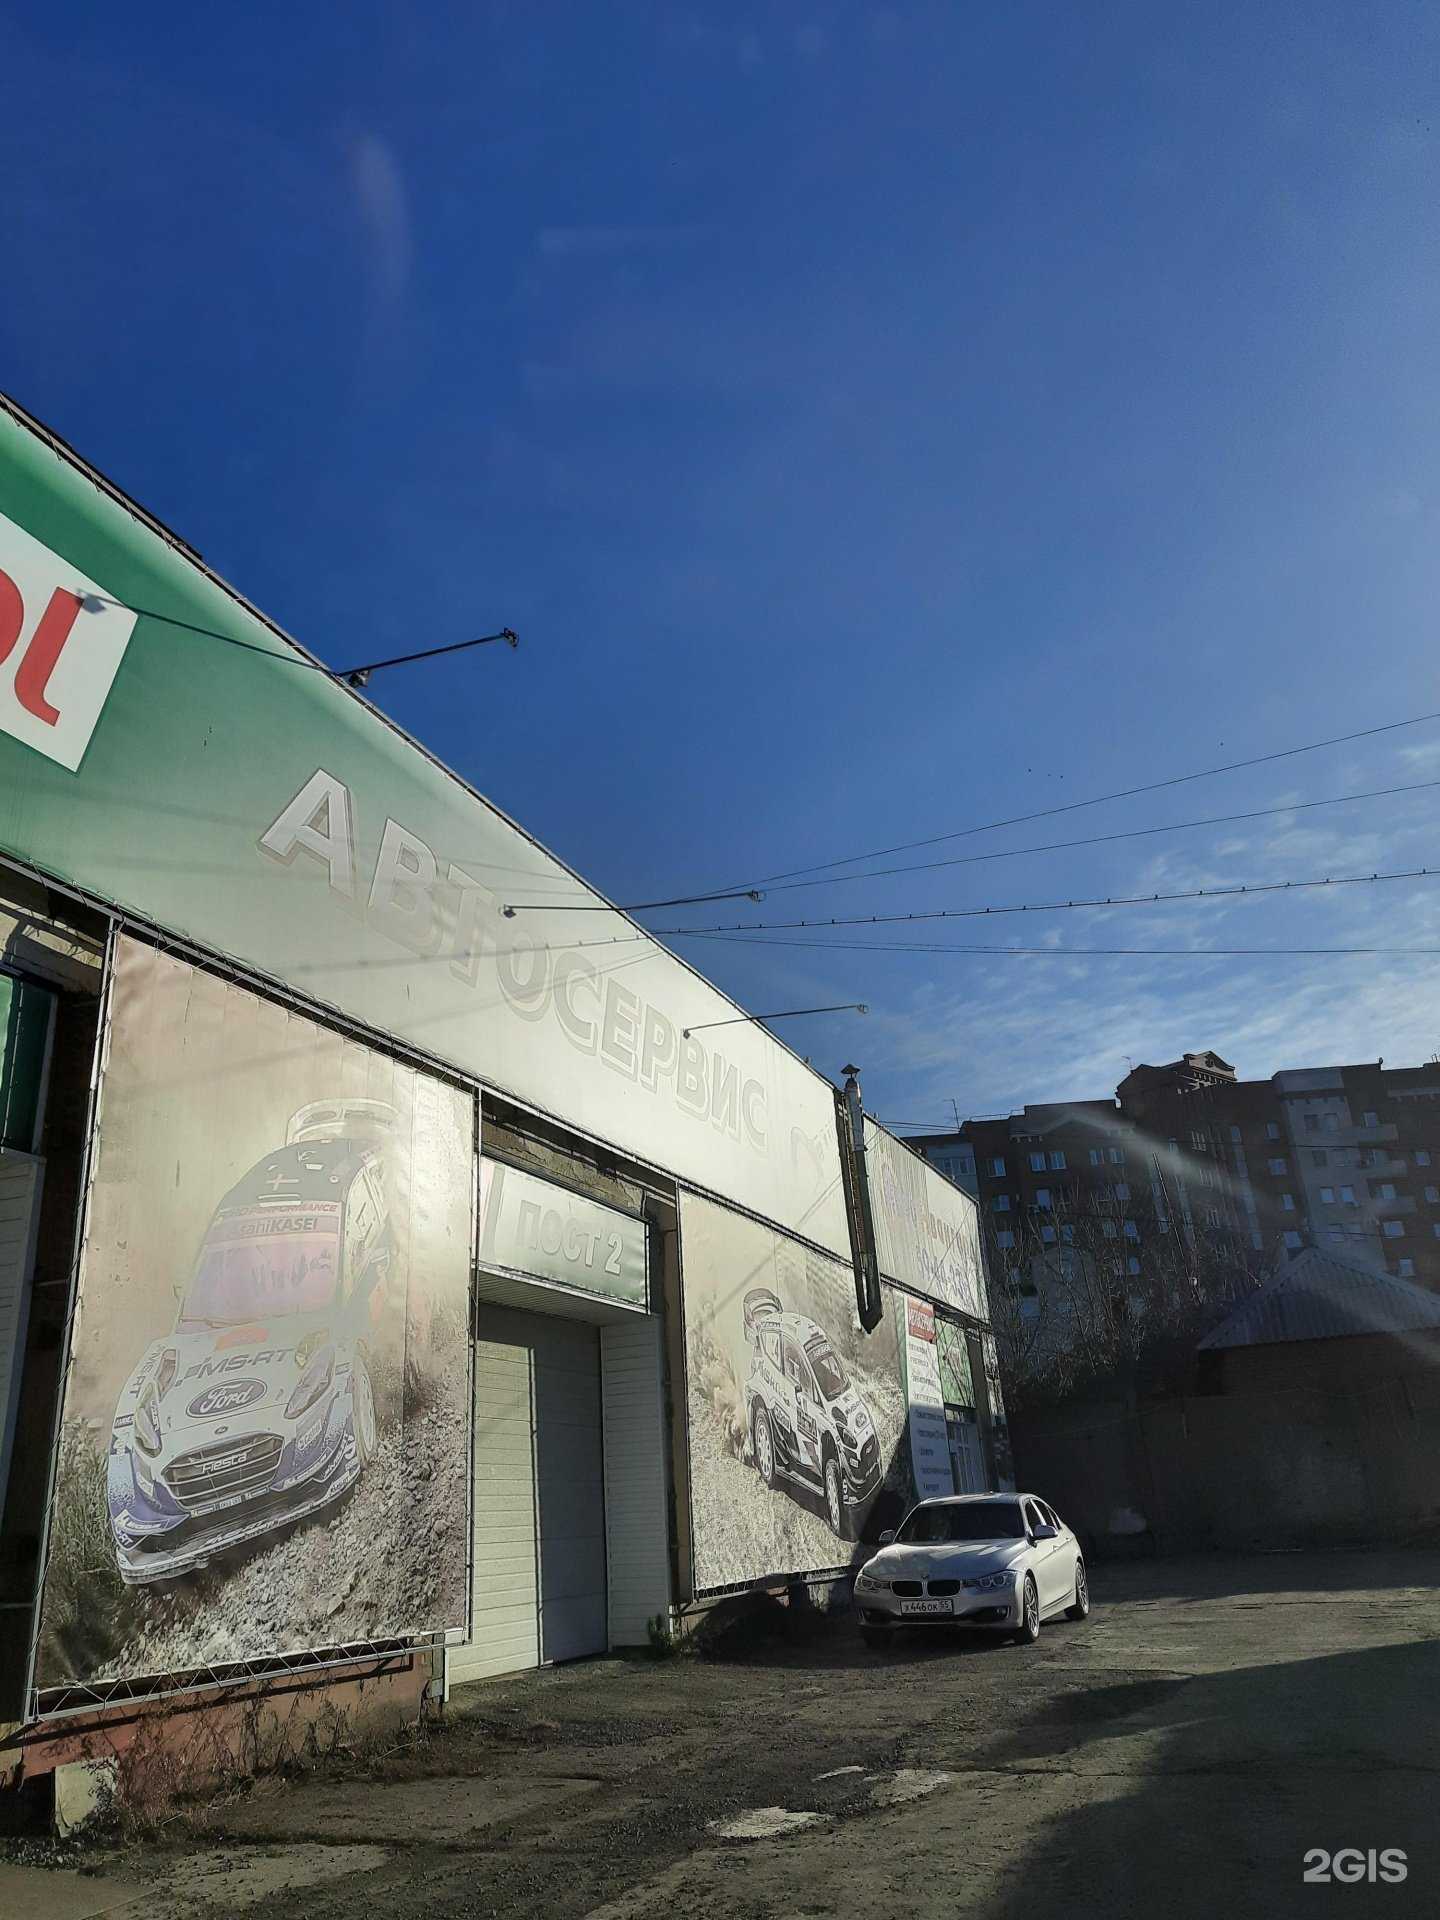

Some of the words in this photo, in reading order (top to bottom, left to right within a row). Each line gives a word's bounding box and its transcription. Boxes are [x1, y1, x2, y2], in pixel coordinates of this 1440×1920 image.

[259, 768, 768, 1152] АВТОСЕРВИС
[516, 1199, 602, 1268] ПОСТ
[604, 1232, 624, 1277] 2
[200, 1383, 254, 1415] Ford
